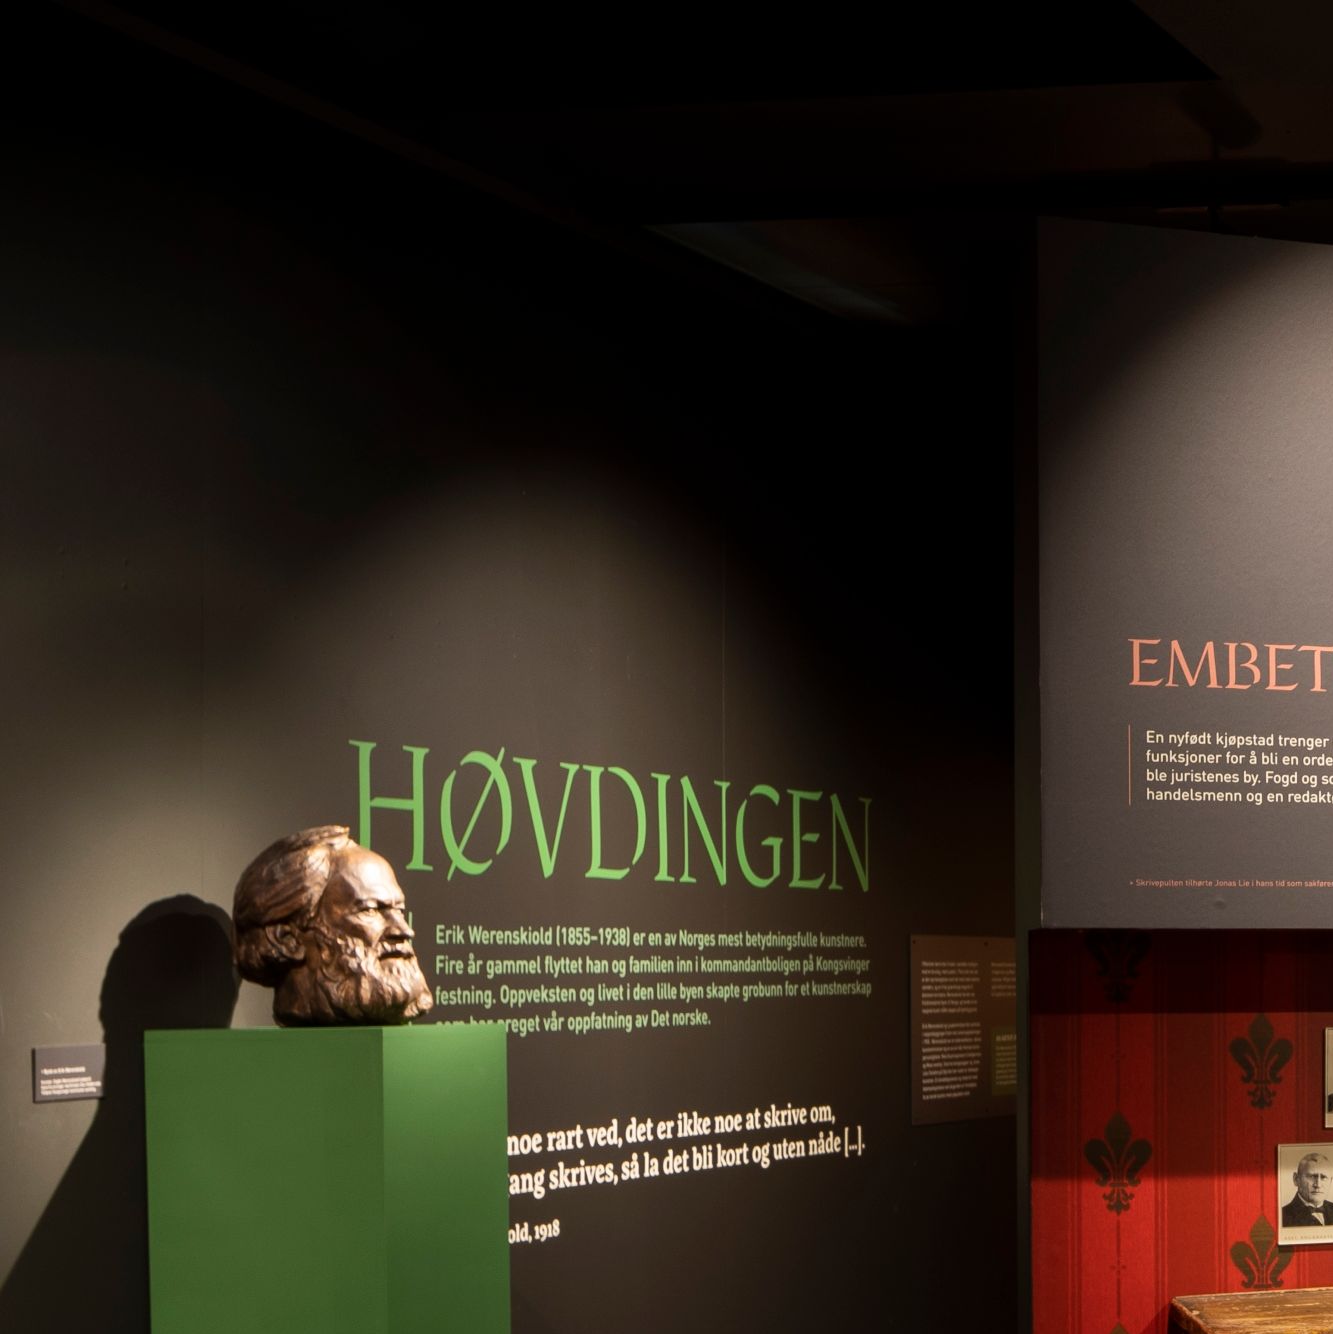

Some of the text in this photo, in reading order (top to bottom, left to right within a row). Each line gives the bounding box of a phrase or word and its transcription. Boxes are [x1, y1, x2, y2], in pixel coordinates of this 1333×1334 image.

[1146, 730, 1164, 743] En
[1168, 731, 1211, 747] nyfødt
[1216, 731, 1274, 749] kjøpstad
[1278, 734, 1329, 751] trenger
[1145, 749, 1222, 766] funksjoner
[1225, 750, 1245, 764] for
[1248, 750, 1257, 765] å
[1261, 751, 1278, 765] bli
[1281, 755, 1298, 765] en
[1146, 768, 1167, 782] ble
[1170, 768, 1239, 785] juristenes
[1243, 770, 1261, 786] by.
[1265, 770, 1297, 787] Fogd
[1301, 774, 1317, 788] og
[1146, 787, 1242, 802] handelsmenn
[1246, 792, 1262, 805] og
[1266, 792, 1283, 802] en
[349, 739, 872, 892] HØVDINGEN
[436, 924, 464, 944] Erik
[467, 925, 552, 945] Werenskiold
[632, 932, 646, 946] er
[647, 932, 662, 946] en
[664, 932, 677, 946] av
[678, 929, 716, 951] Norges
[717, 931, 743, 947] mest
[745, 930, 817, 951] betydningsfulle
[820, 931, 867, 949] kunstnere.
[506, 1102, 835, 1156] noe rart ved, det er ikke noe at skrive om,
[508, 1168, 545, 1199] ang
[548, 1162, 618, 1190] skrives,
[620, 1156, 640, 1181] så
[643, 1155, 659, 1177] la
[662, 1151, 689, 1175] det
[692, 1148, 713, 1171] bli
[716, 1144, 749, 1168] kort
[751, 1142, 770, 1169] og
[772, 1139, 805, 1160] uten
[808, 1134, 841, 1156] nåde
[508, 1218, 560, 1244] old, 1918
